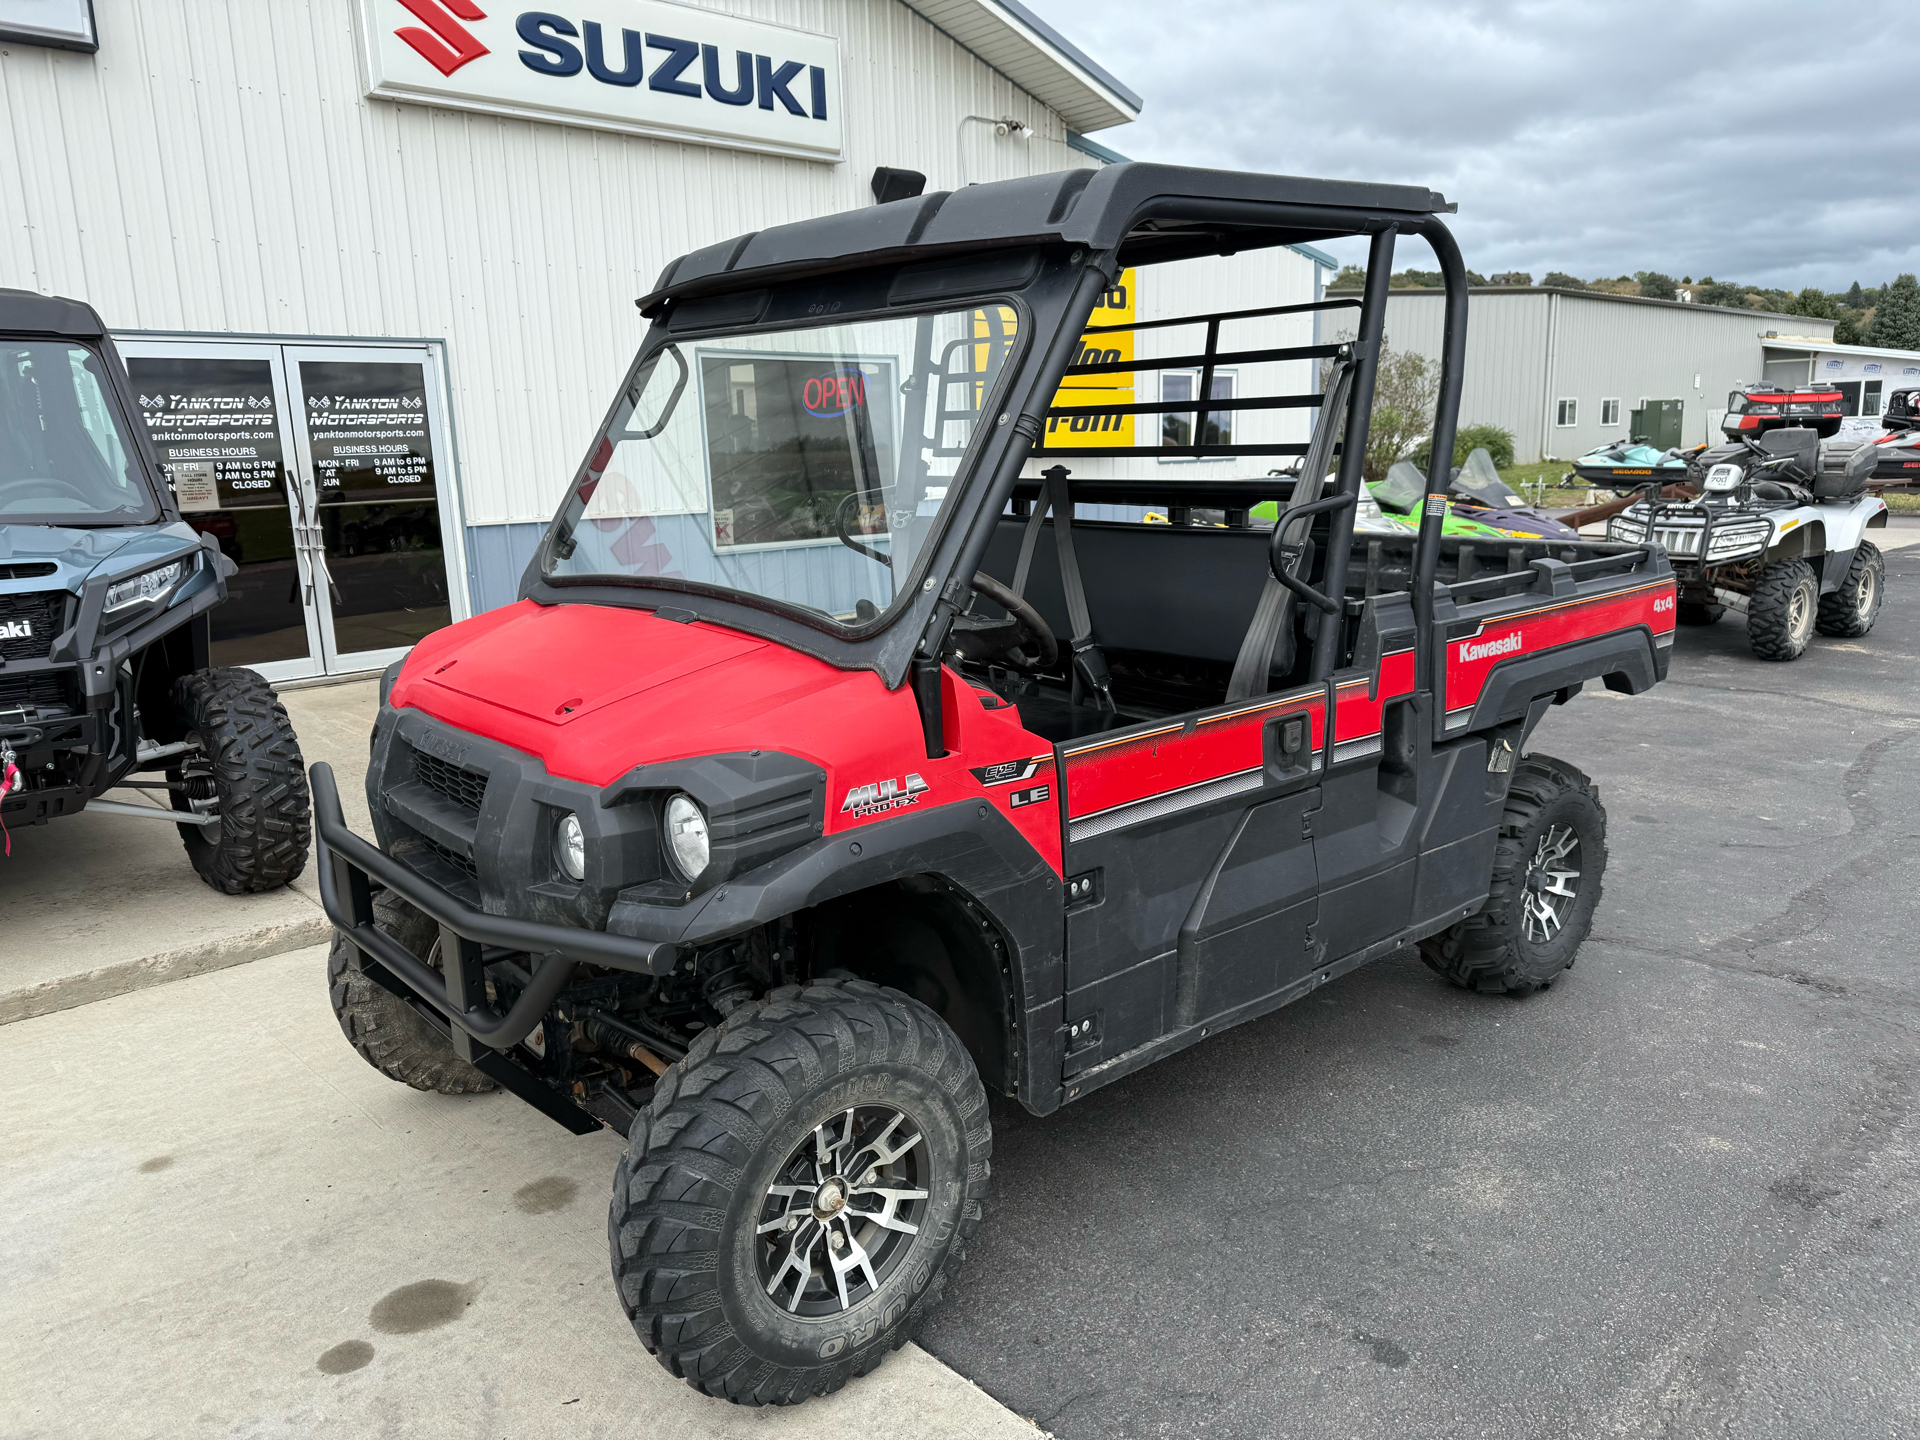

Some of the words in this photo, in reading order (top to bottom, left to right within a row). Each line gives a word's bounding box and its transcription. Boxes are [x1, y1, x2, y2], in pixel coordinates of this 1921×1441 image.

[516, 11, 828, 121] SUZUKI
[804, 377, 864, 409] OPEN
[170, 395, 244, 409] YANKTON
[334, 396, 399, 409] YANKTON
[143, 412, 273, 426] MOTORSPORTS
[309, 412, 424, 425] MOTORSPORTS
[151, 430, 274, 441] anktonmotorsports.com
[313, 429, 424, 441] yanktonmotorsports.com
[168, 448, 220, 457] BUSINESS
[221, 447, 257, 456] HOURS
[333, 445, 377, 454] BUSINESS
[379, 444, 409, 453] HOURS
[183, 462, 199, 471] FRI
[216, 462, 223, 470] 9
[226, 461, 241, 470] AM
[242, 461, 252, 469] to
[254, 461, 260, 469] 6
[261, 460, 276, 469] PM
[318, 460, 340, 468] MON
[345, 459, 360, 467] FRI
[374, 458, 380, 466] 9
[382, 457, 395, 466] AM
[396, 457, 405, 465] to
[406, 457, 412, 465] 6
[412, 456, 426, 465] PM
[216, 471, 223, 480] 9
[225, 471, 240, 480] AM
[241, 471, 252, 479] to
[253, 471, 260, 479] 5
[261, 470, 276, 478] PM
[375, 467, 381, 475] 9
[383, 466, 397, 475] AM
[397, 466, 406, 474] to
[407, 466, 413, 474] 5
[413, 465, 427, 473] PM
[232, 480, 271, 489] CLOSED
[387, 474, 421, 484] CLOSED
[1653, 595, 1673, 613] 4x4
[1459, 631, 1522, 663] Kawasaki
[985, 761, 1017, 778] EPS
[840, 773, 930, 813] MULE
[1011, 786, 1049, 807] LE
[853, 795, 919, 819] PRO-FX
[817, 1259, 933, 1360] DURO
